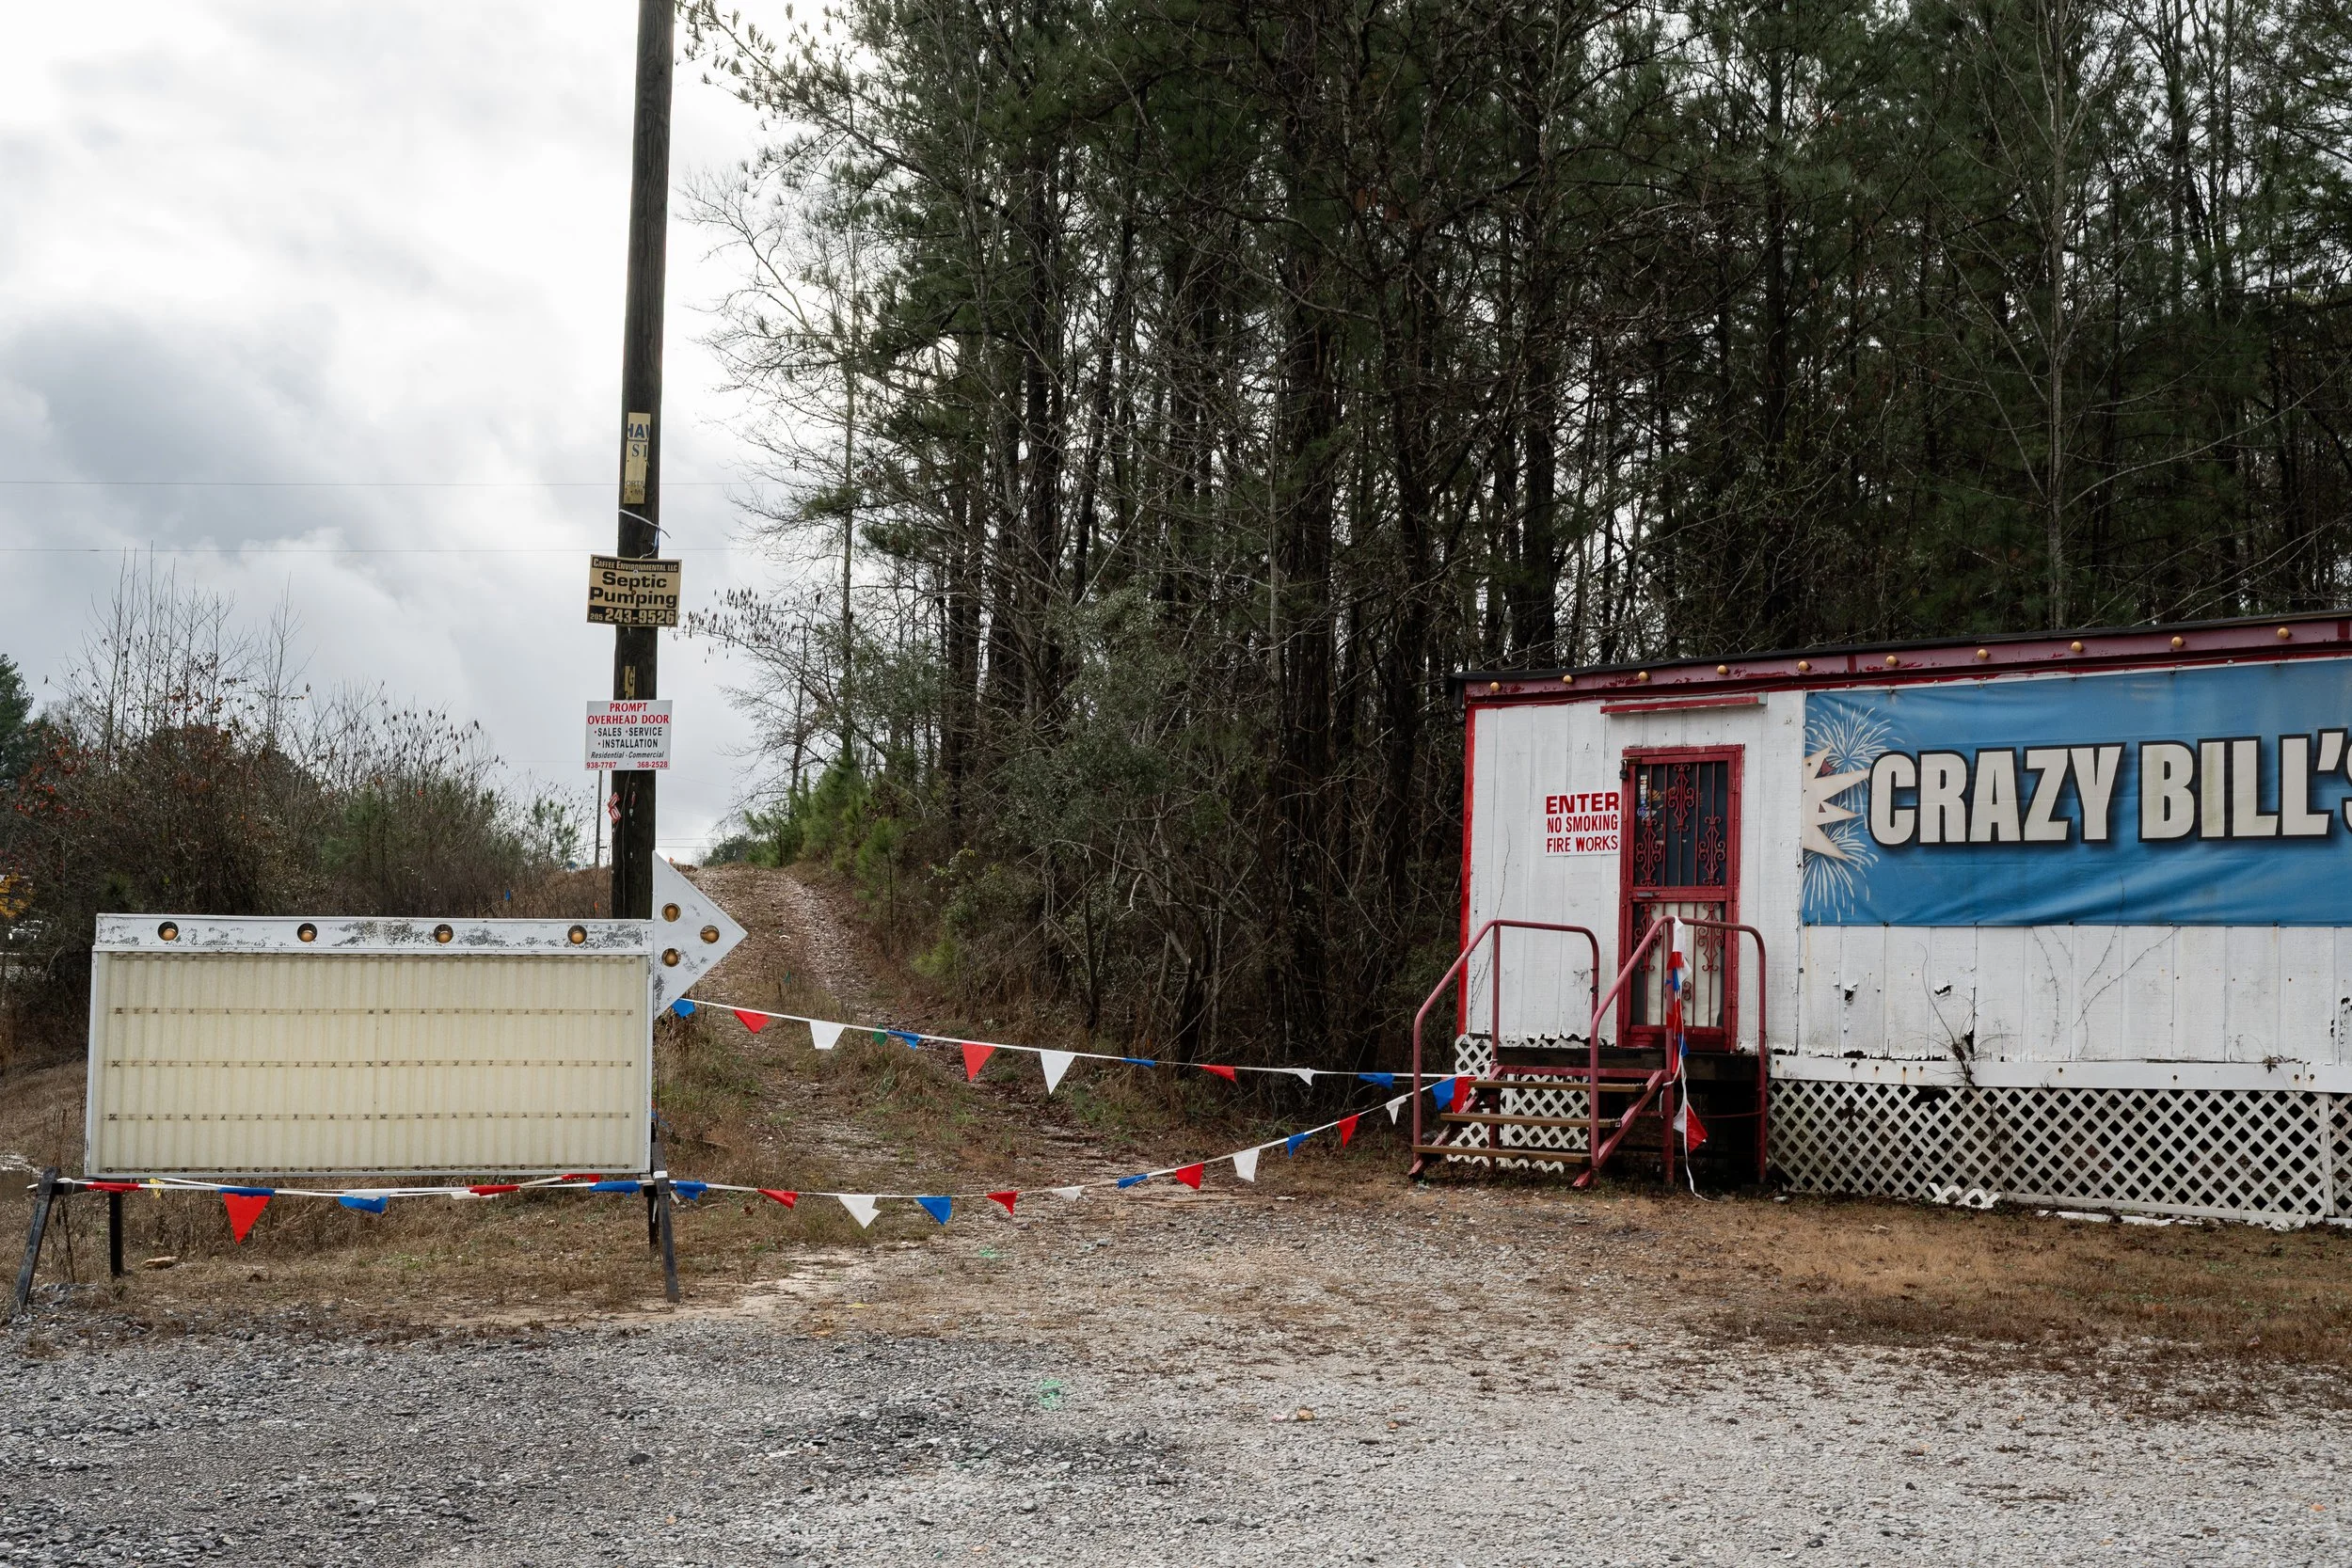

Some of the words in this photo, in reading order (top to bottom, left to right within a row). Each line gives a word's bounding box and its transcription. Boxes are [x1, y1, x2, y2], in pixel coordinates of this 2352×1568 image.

[616, 561, 666, 572] ENVIRONMENTAL
[602, 571, 667, 591] Septic
[590, 587, 677, 609] Pumping
[590, 612, 603, 621] 205
[605, 608, 675, 625] 243-9526
[610, 703, 647, 712] PROMPT
[587, 715, 637, 725] OVERHEAD
[641, 714, 669, 724] DOOR
[628, 751, 664, 759] Commercial
[637, 760, 668, 768] 368-2528
[1868, 741, 2127, 847] CRAZY
[2137, 728, 2352, 844] BILL'
[1546, 792, 1619, 815] ENTER
[1547, 816, 1562, 833] NO
[1565, 814, 1618, 833] SMOKING
[1547, 836, 1571, 853] FIRE
[1576, 835, 1618, 852] WORKS
